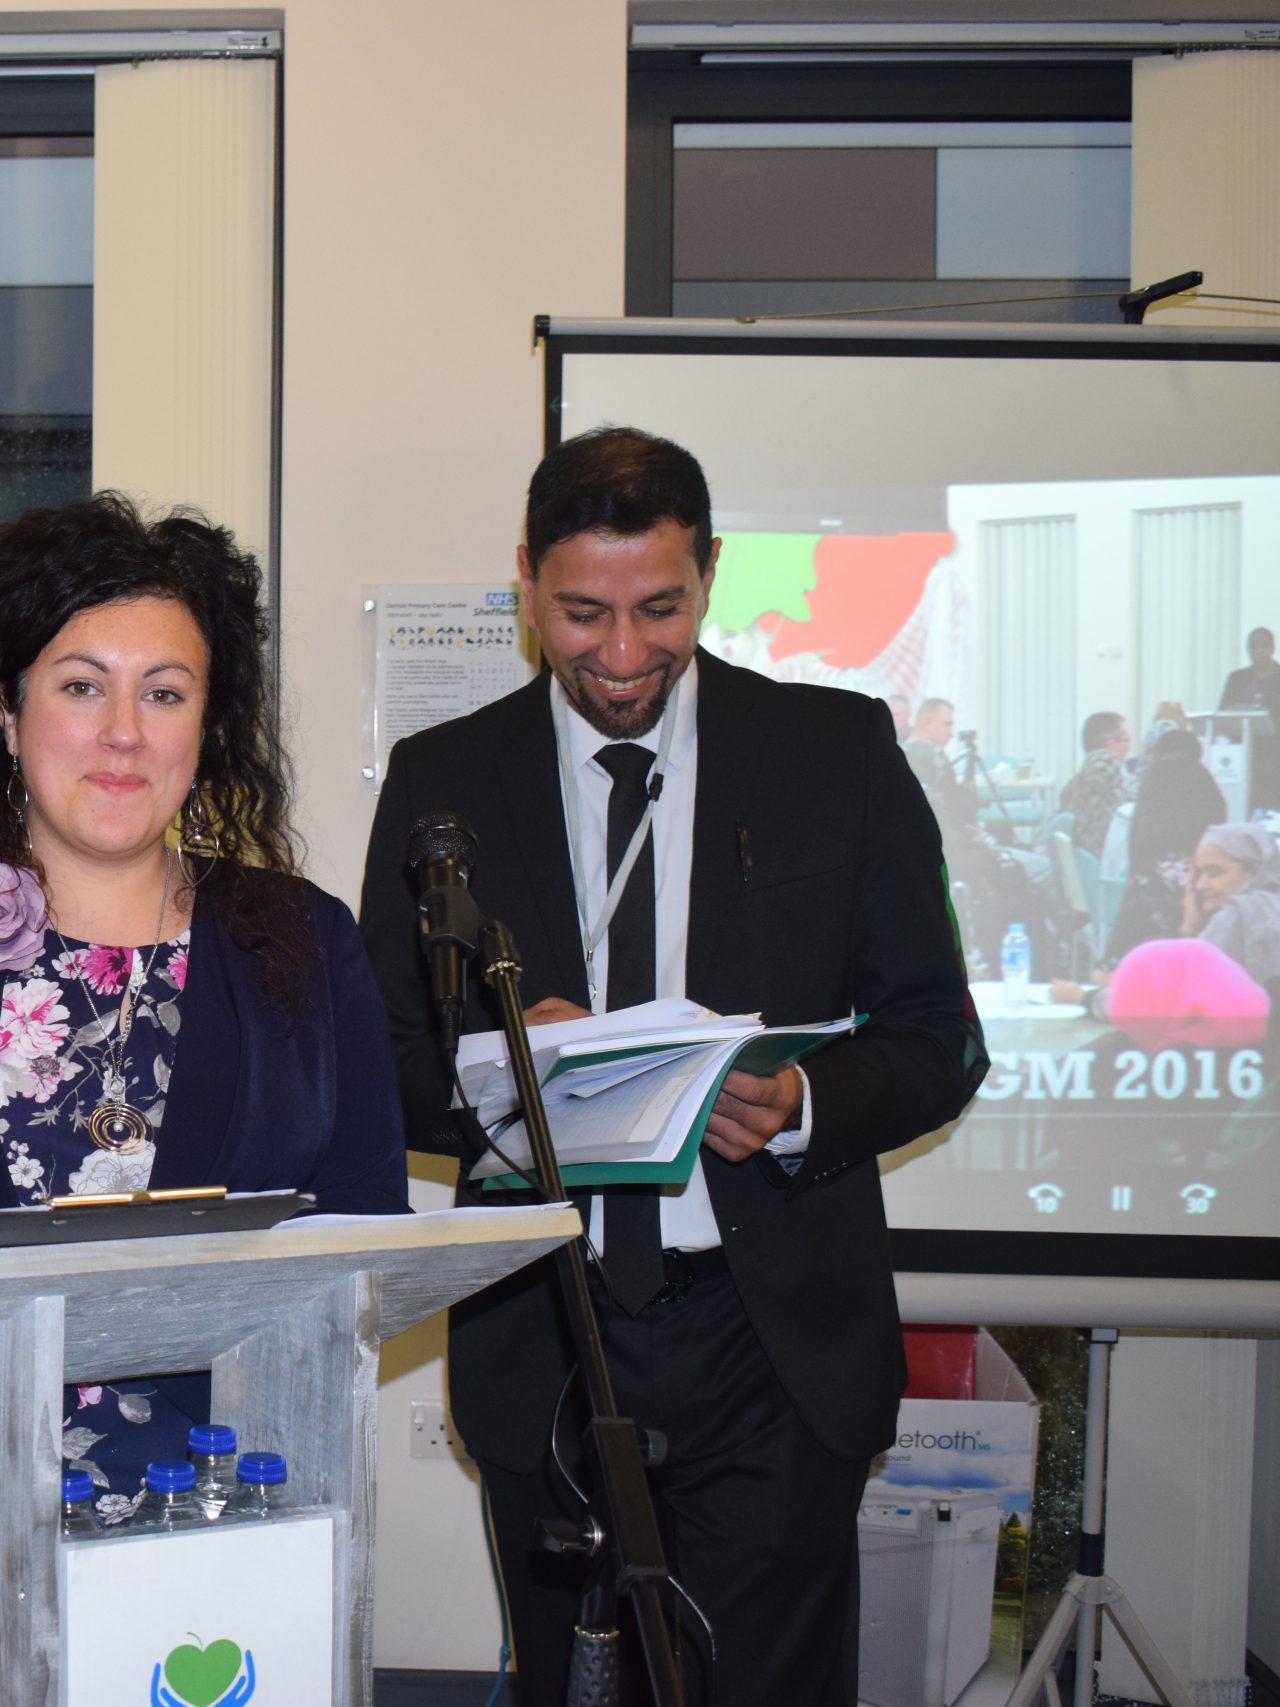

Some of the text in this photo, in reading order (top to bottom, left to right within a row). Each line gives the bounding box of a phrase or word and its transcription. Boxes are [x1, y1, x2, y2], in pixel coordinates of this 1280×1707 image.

[486, 593, 518, 606] NHS
[473, 608, 518, 617] Sheffield
[1113, 1049, 1264, 1100] 2016
